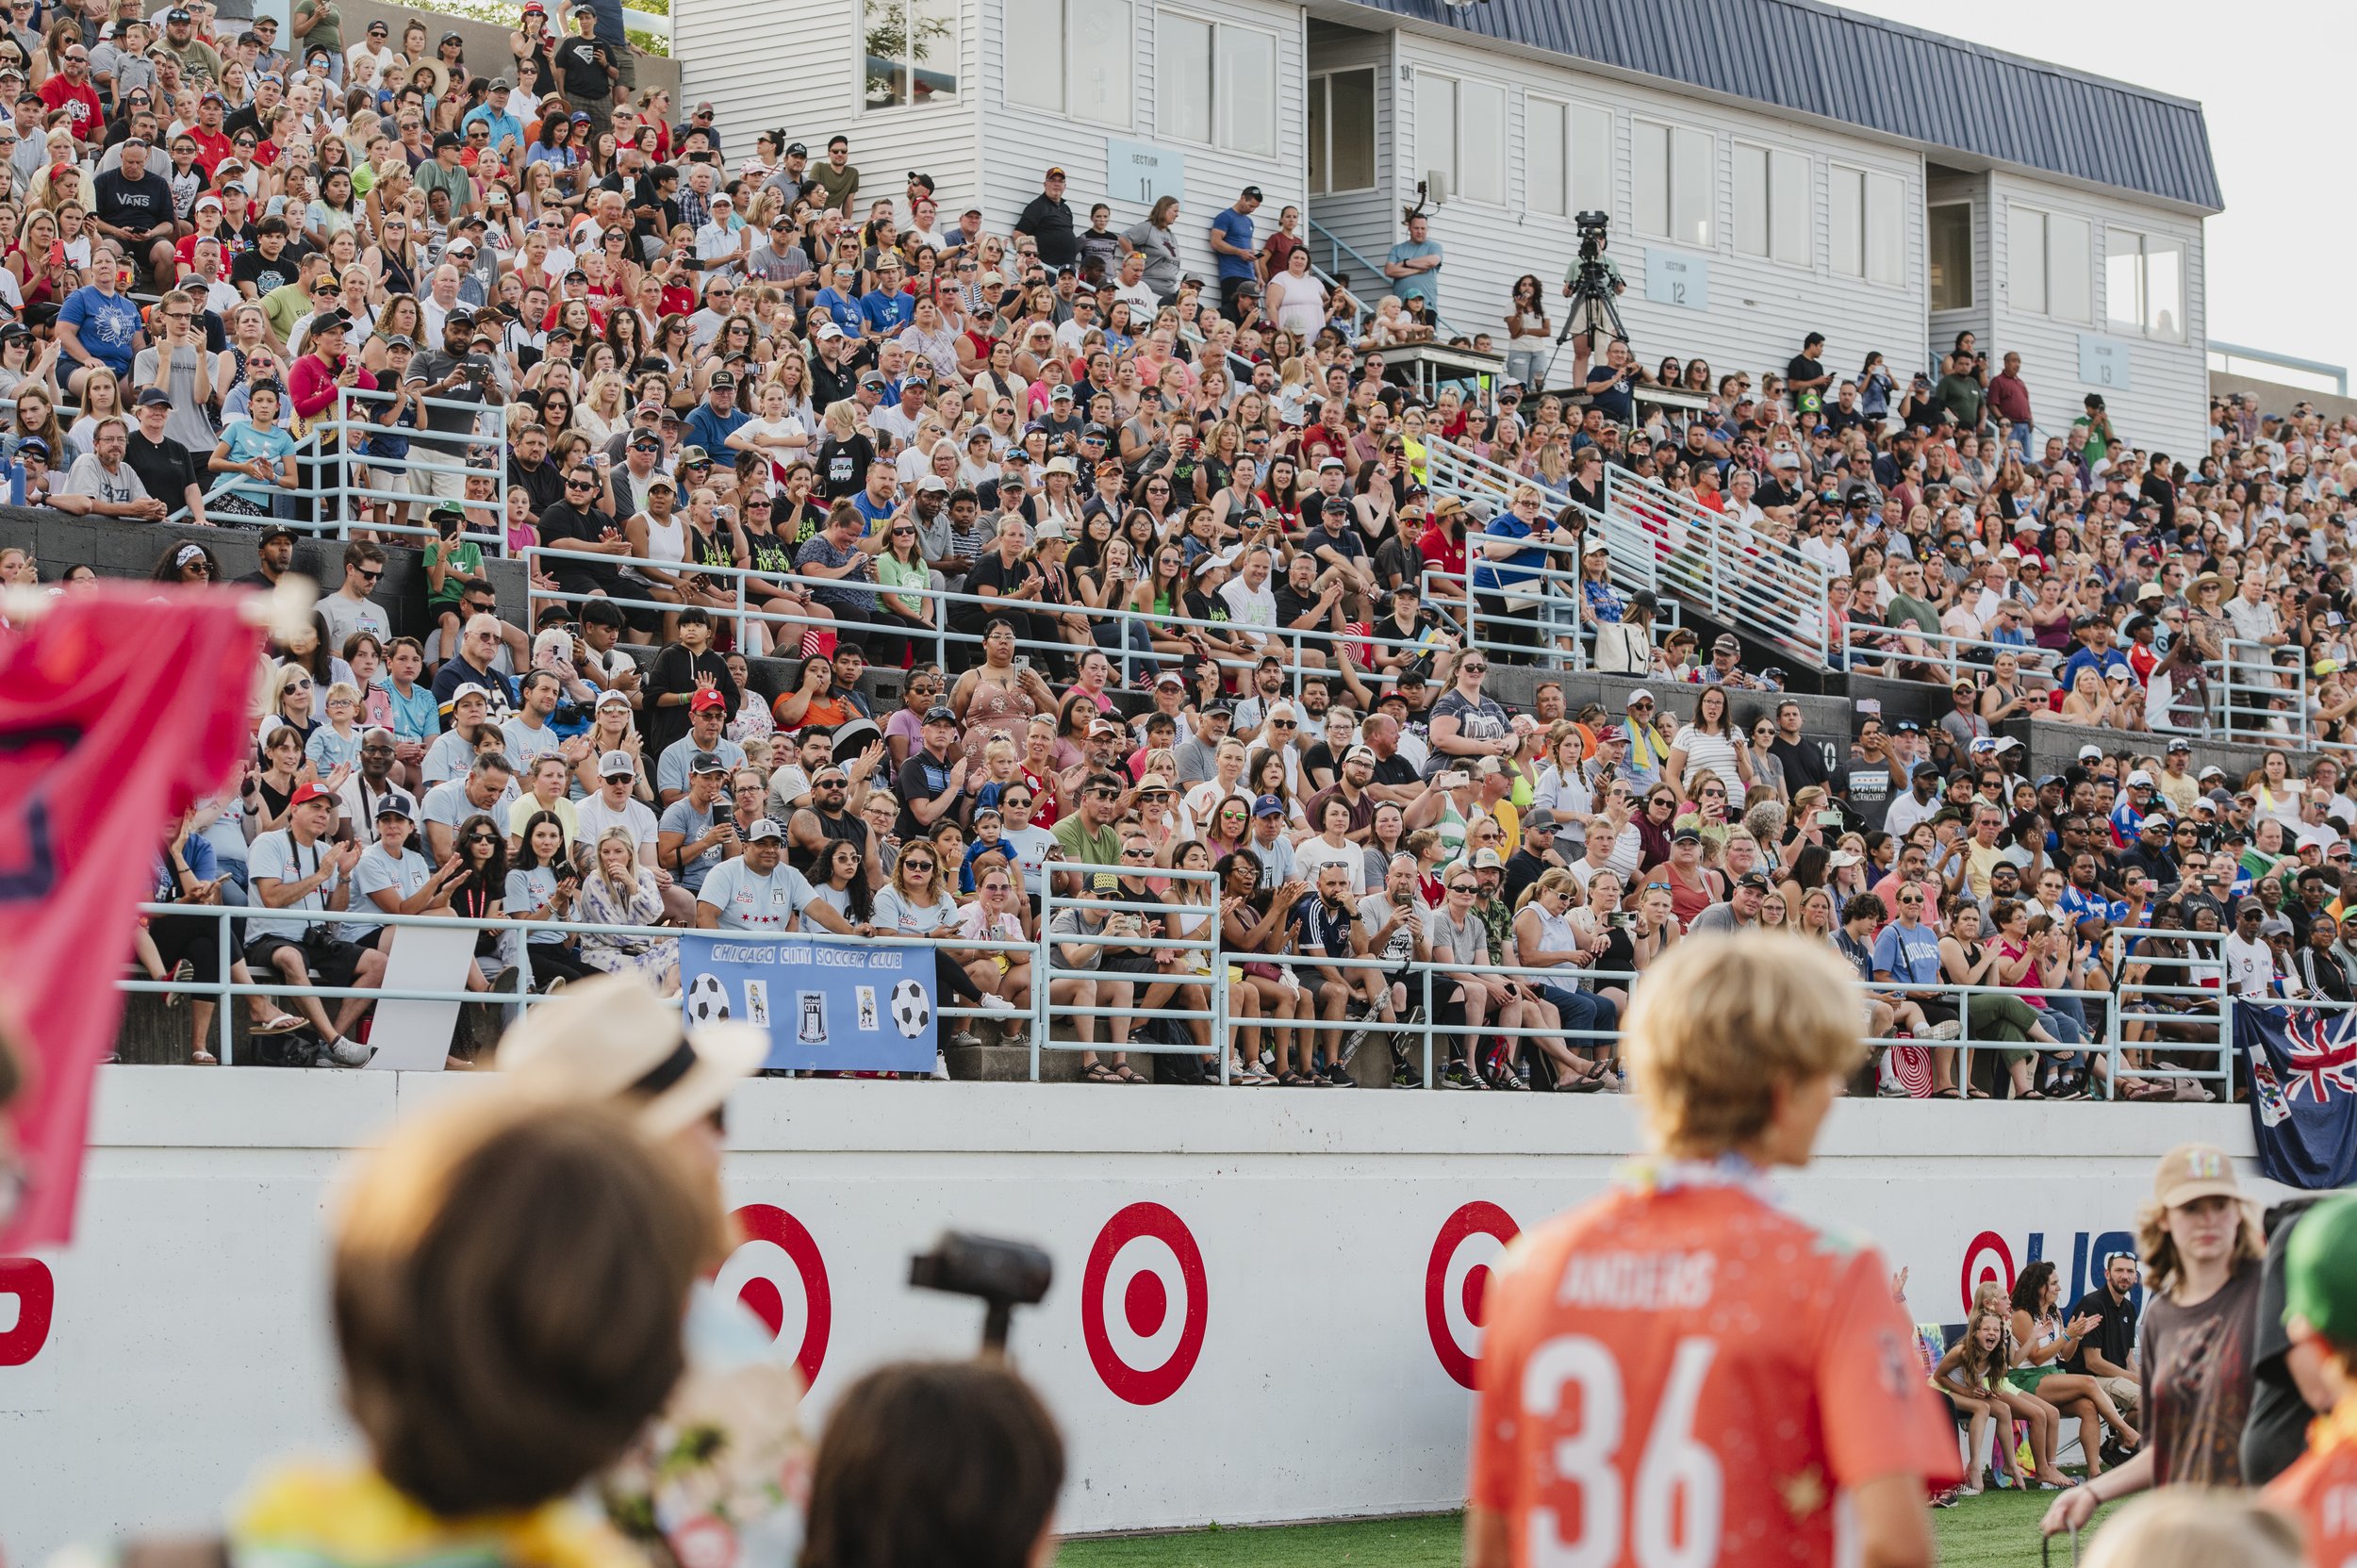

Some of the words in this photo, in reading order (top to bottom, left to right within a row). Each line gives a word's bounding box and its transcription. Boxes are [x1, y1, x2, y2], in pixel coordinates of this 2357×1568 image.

[62, 103, 91, 115] SOCCER
[1131, 154, 1158, 168] SECTION
[1139, 177, 1151, 203] 11
[116, 192, 151, 207] VANS
[1665, 260, 1687, 272] SECTION
[1672, 282, 1685, 304] 12
[2100, 365, 2112, 385] 13
[355, 625, 380, 635] USA
[736, 896, 754, 904] CUP
[738, 890, 754, 899] USA
[899, 917, 918, 927] CUP
[902, 913, 917, 921] USA
[713, 945, 775, 963] CHICAGO
[781, 947, 812, 964] CITY
[816, 949, 866, 966] SOCCER
[869, 952, 902, 968] CLUB
[804, 1003, 821, 1013] CITY
[1560, 1250, 1717, 1311] ANDERS
[1521, 1331, 1725, 1568] 36
